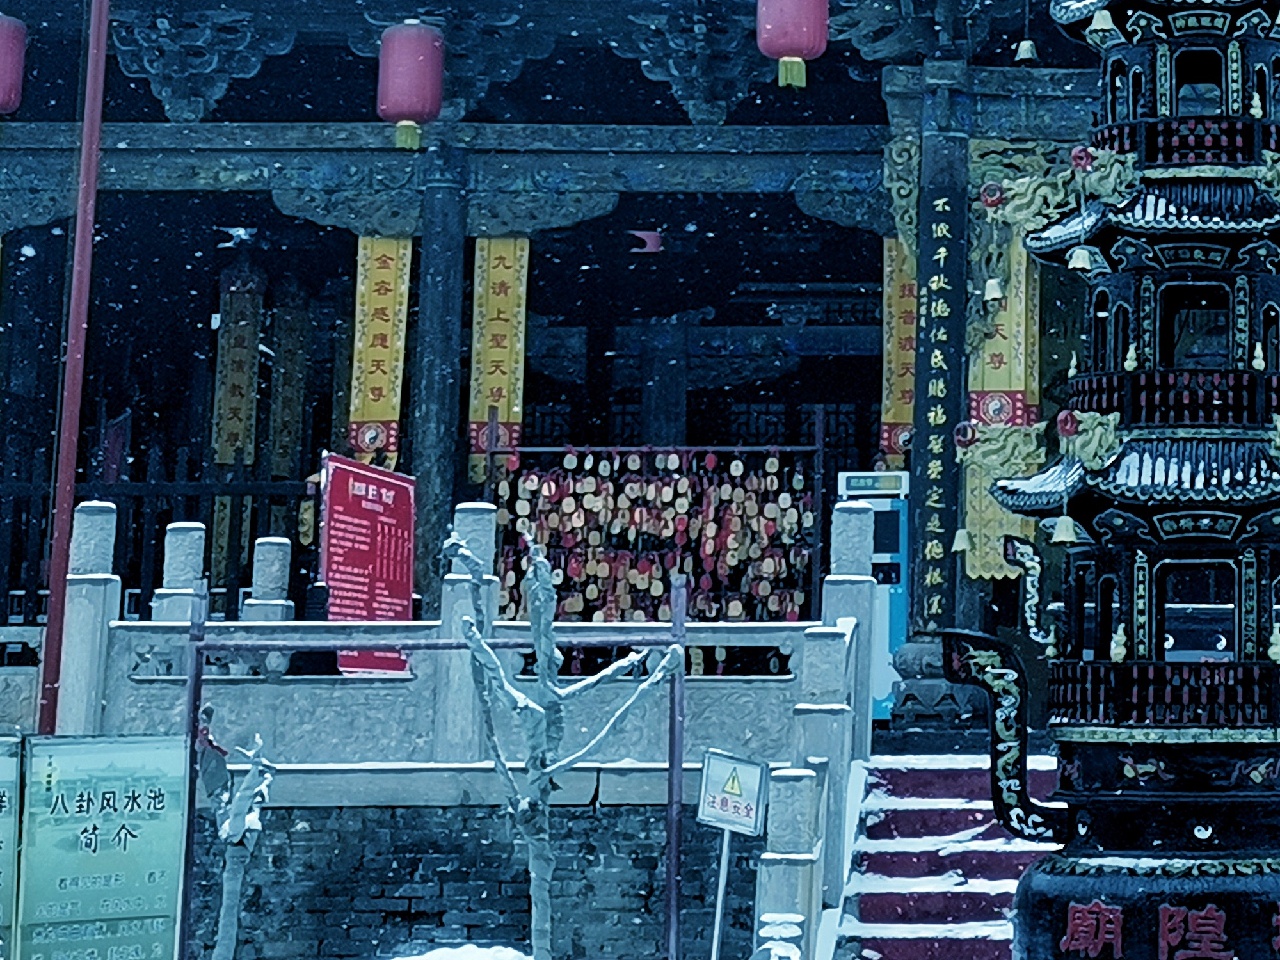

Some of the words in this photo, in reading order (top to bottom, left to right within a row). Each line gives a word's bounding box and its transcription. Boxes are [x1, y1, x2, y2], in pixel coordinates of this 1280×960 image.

[50, 788, 165, 815] 八卦风水池
[80, 823, 138, 853] 简介
